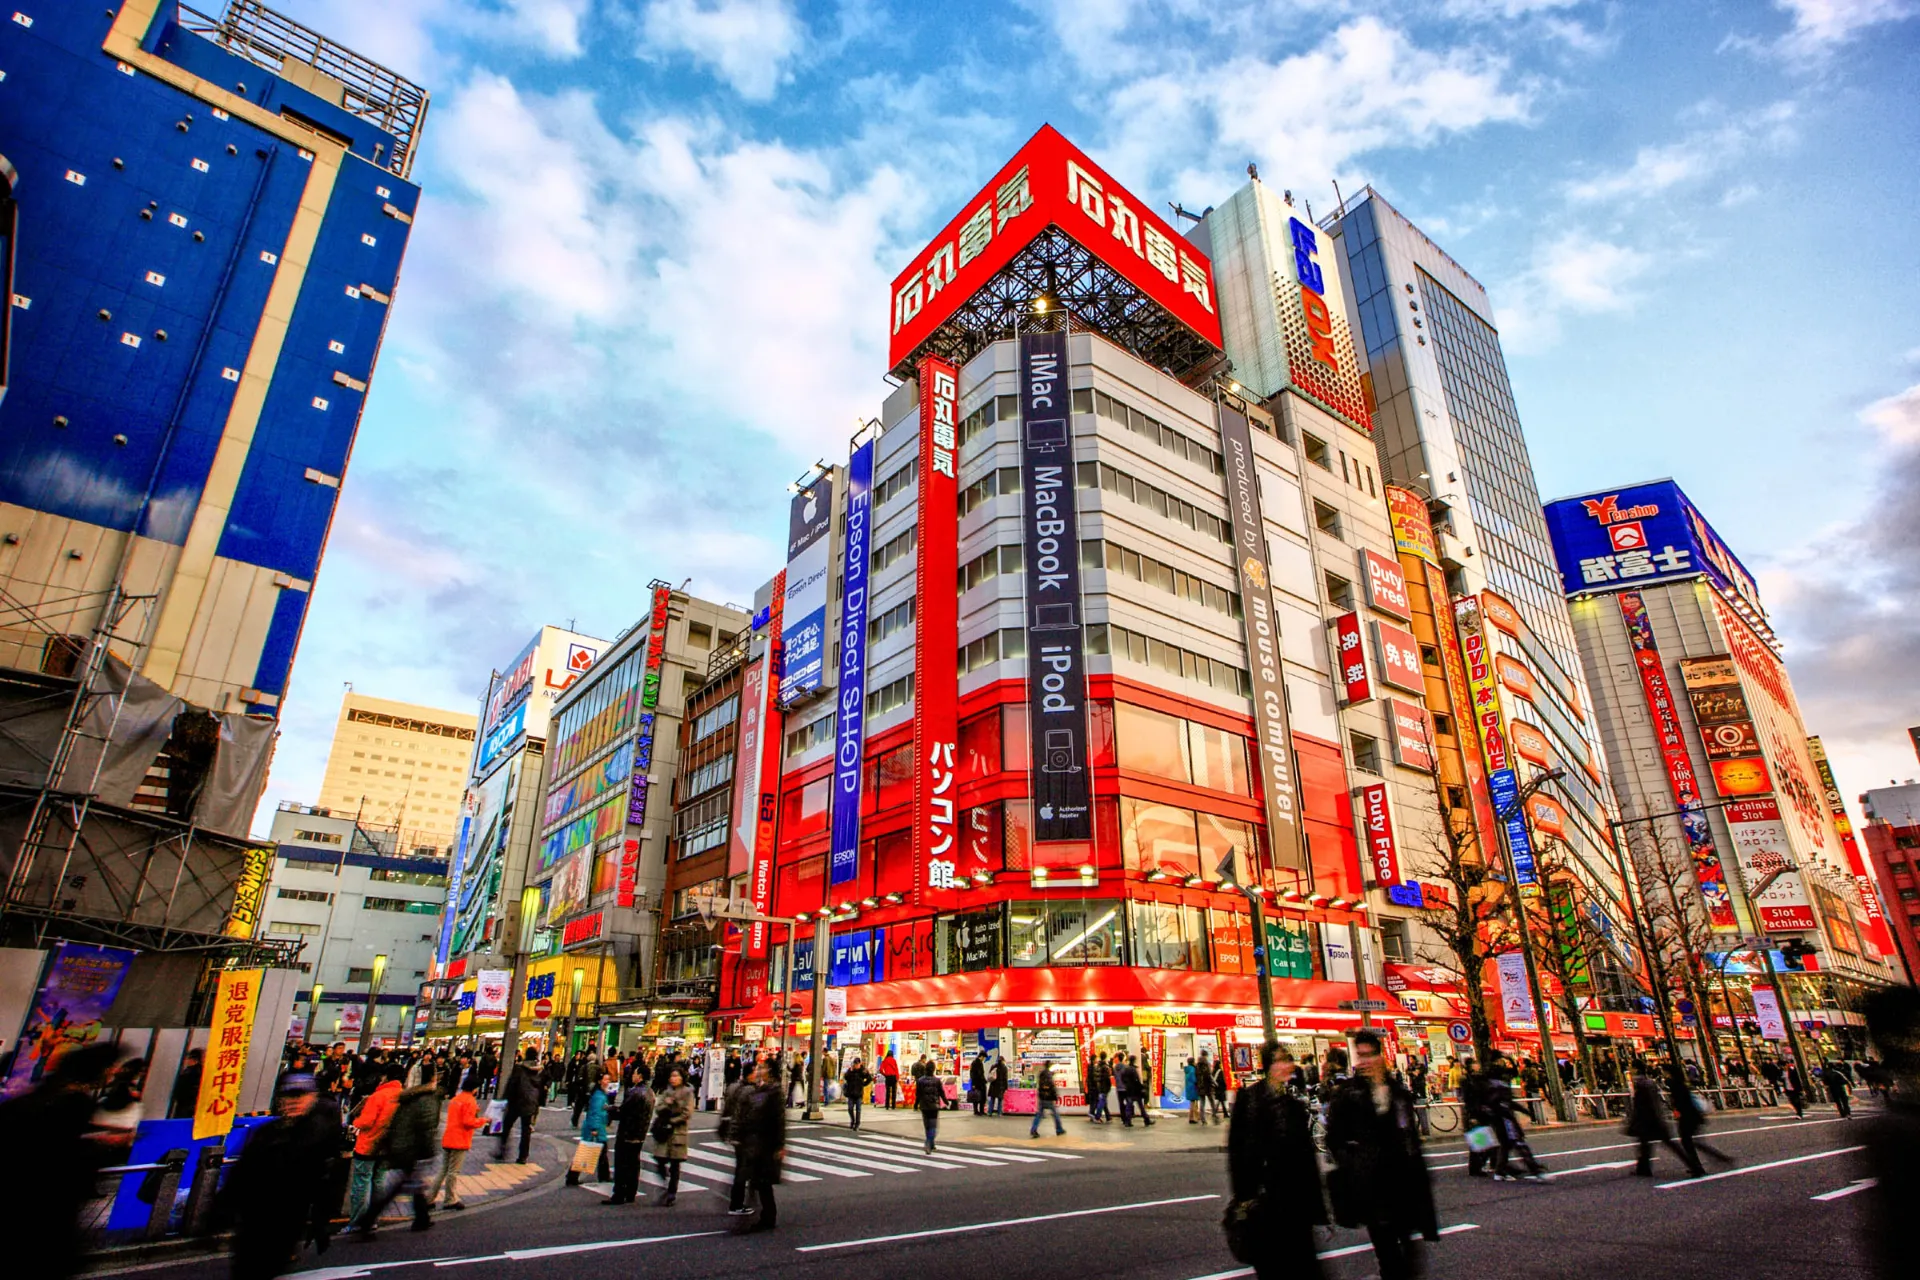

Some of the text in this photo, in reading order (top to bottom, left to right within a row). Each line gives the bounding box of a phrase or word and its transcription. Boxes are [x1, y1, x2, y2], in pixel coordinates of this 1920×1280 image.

[893, 164, 1034, 336] 石丸電気
[1067, 160, 1215, 315] 石丸電気
[1030, 354, 1058, 409] iMac
[933, 371, 955, 479] 石丸電気
[1230, 438, 1257, 554] produced by
[1628, 504, 1659, 519] shop
[1034, 466, 1069, 591] MacBook
[788, 567, 827, 600] Epson Direct
[1370, 559, 1402, 591] Duty
[1579, 545, 1691, 584] 武富士
[1372, 579, 1405, 608] Free
[840, 490, 867, 793] Epson Direct SHOP
[1342, 631, 1366, 684] 免税
[1385, 642, 1421, 675] 免税
[545, 668, 578, 690] LA
[1041, 645, 1075, 713] iPod
[1252, 598, 1294, 825] mouse computer
[1648, 674, 1679, 746] 完全補完計画
[638, 713, 656, 769] オーディオ
[928, 742, 956, 888] パソコン館
[1726, 801, 1776, 812] Pachinko
[1741, 811, 1764, 820] Slot
[834, 849, 856, 864] EPSON
[1368, 789, 1392, 880] Duty Free
[232, 848, 267, 924] GAMERS
[757, 859, 769, 899] Watch
[756, 901, 765, 910] &
[1771, 908, 1795, 917] Slot
[1862, 892, 1881, 918] APPLE
[836, 939, 881, 965] FMV
[1035, 1011, 1104, 1024] ISHIMARU
[206, 980, 250, 1117] 退党服務中心
